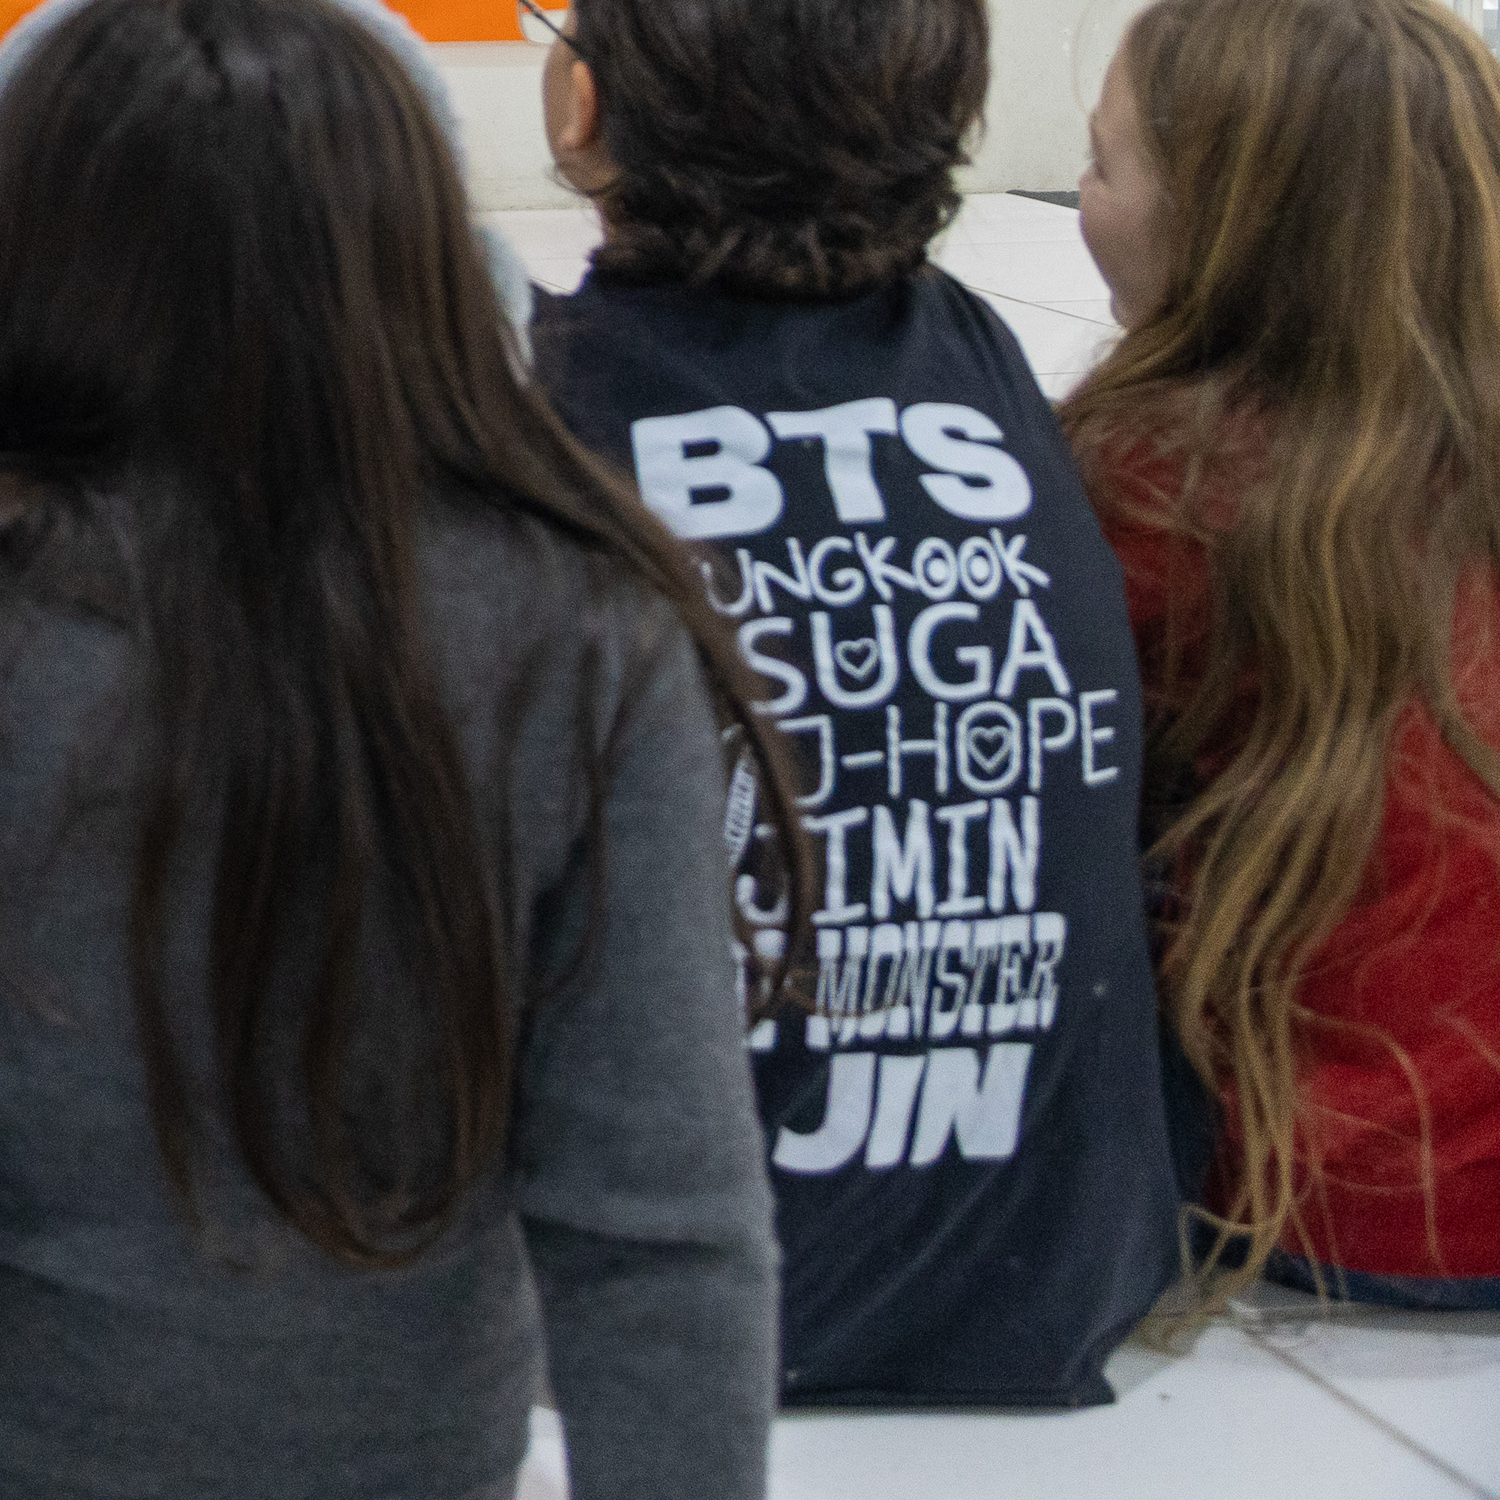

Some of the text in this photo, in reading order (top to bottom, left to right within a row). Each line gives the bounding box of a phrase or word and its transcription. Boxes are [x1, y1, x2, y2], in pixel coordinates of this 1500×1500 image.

[631, 396, 1033, 541] BTS
[702, 527, 1051, 617] UNGKOOK
[737, 597, 1071, 716] SUGA
[778, 689, 1118, 807] J-HOPE
[804, 911, 1067, 1049] MONSTER
[773, 1042, 1035, 1174] JIN
